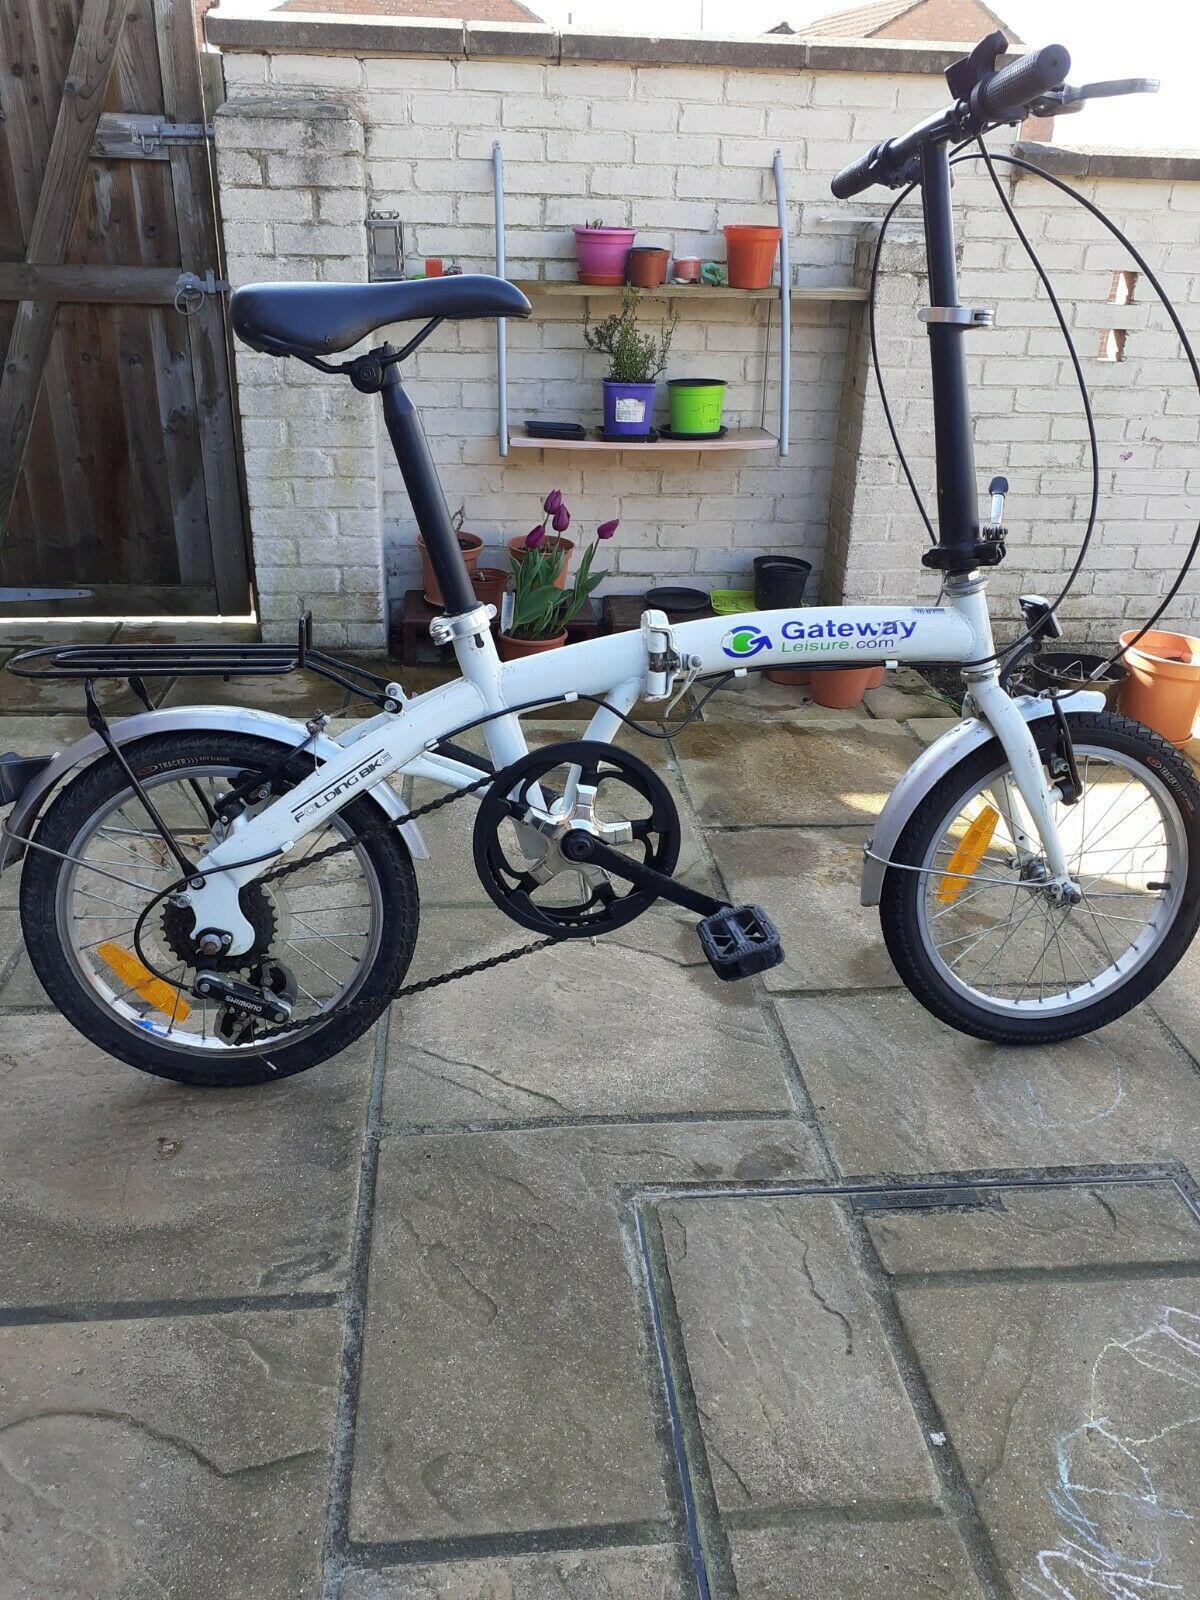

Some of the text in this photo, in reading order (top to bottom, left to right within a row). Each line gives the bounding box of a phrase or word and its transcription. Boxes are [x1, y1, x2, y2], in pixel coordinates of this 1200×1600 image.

[781, 619, 917, 640] Gateway
[781, 637, 894, 653] Leisure.com
[158, 758, 186, 770] TRACER
[294, 752, 393, 823] FOLDING BIKE
[224, 995, 263, 1013] SHIMANO
